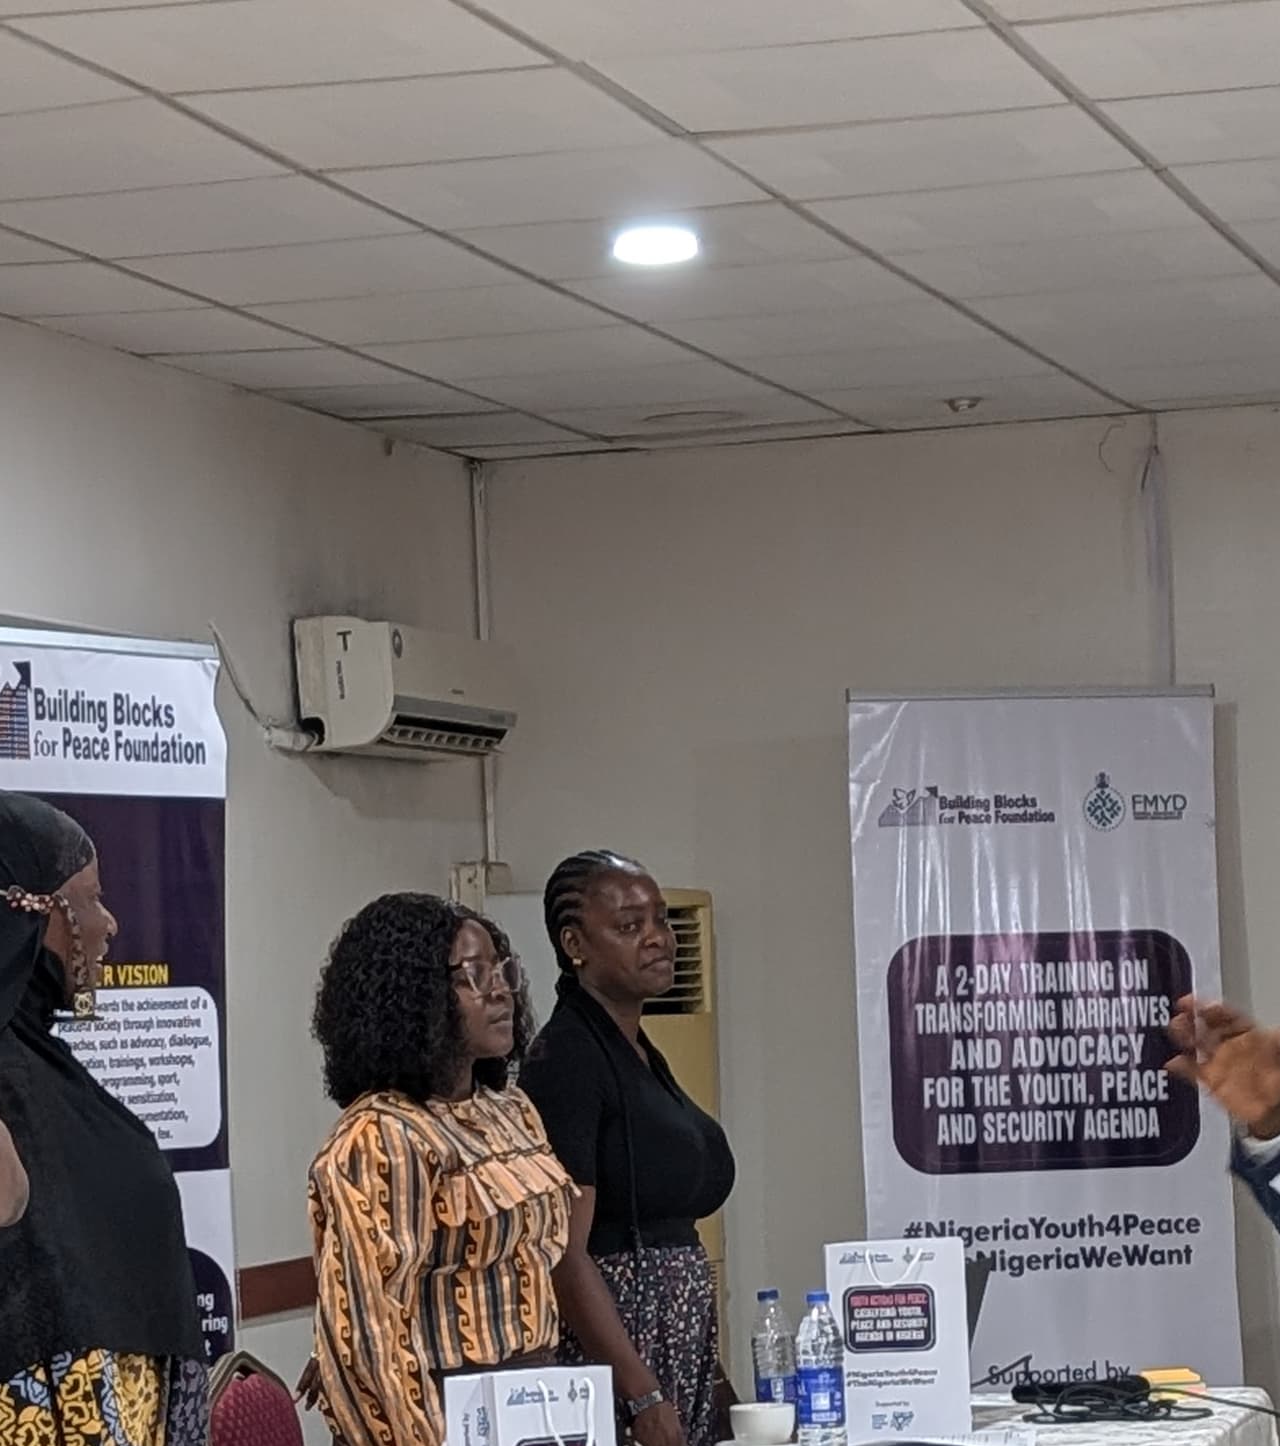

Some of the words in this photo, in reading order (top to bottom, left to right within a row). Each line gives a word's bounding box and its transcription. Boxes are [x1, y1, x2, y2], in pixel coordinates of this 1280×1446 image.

[33, 687, 108, 733] Building
[113, 692, 175, 729] Blocks
[33, 730, 59, 757] for
[62, 727, 110, 761] Peace
[114, 730, 206, 765] Foundation
[938, 795, 990, 812] Building
[994, 793, 1038, 809] Blocks
[938, 812, 955, 824] for
[958, 810, 992, 824] Peace
[995, 808, 1056, 824] Foundation
[1131, 794, 1188, 811] FMYD
[117, 963, 168, 986] VISION
[935, 966, 950, 996] A
[955, 961, 1012, 996] 2-DAY
[1019, 959, 1115, 994] TRAINING
[1121, 959, 1149, 991] ON
[914, 1000, 1057, 1035] TRANSFORMING
[1061, 995, 1170, 1029] NARRATIVES
[169, 1033, 213, 1050] dialogue,
[950, 1038, 1002, 1071] AND
[1011, 1033, 1145, 1068] ADVOCACY
[923, 1077, 964, 1109] FOR
[971, 1075, 1011, 1107] THE
[1018, 1072, 1094, 1105] YOUTH,
[1101, 1069, 1169, 1102] PEACE
[937, 1113, 977, 1146] AND
[983, 1109, 1076, 1144] SECURITY
[1083, 1106, 1160, 1140] AGENDA
[903, 1213, 1202, 1248] #NigeriaYouth4Peace
[965, 1243, 1193, 1277] NigeriaWeWant
[201, 1313, 228, 1334] ring
[988, 1359, 1097, 1387] Supported
